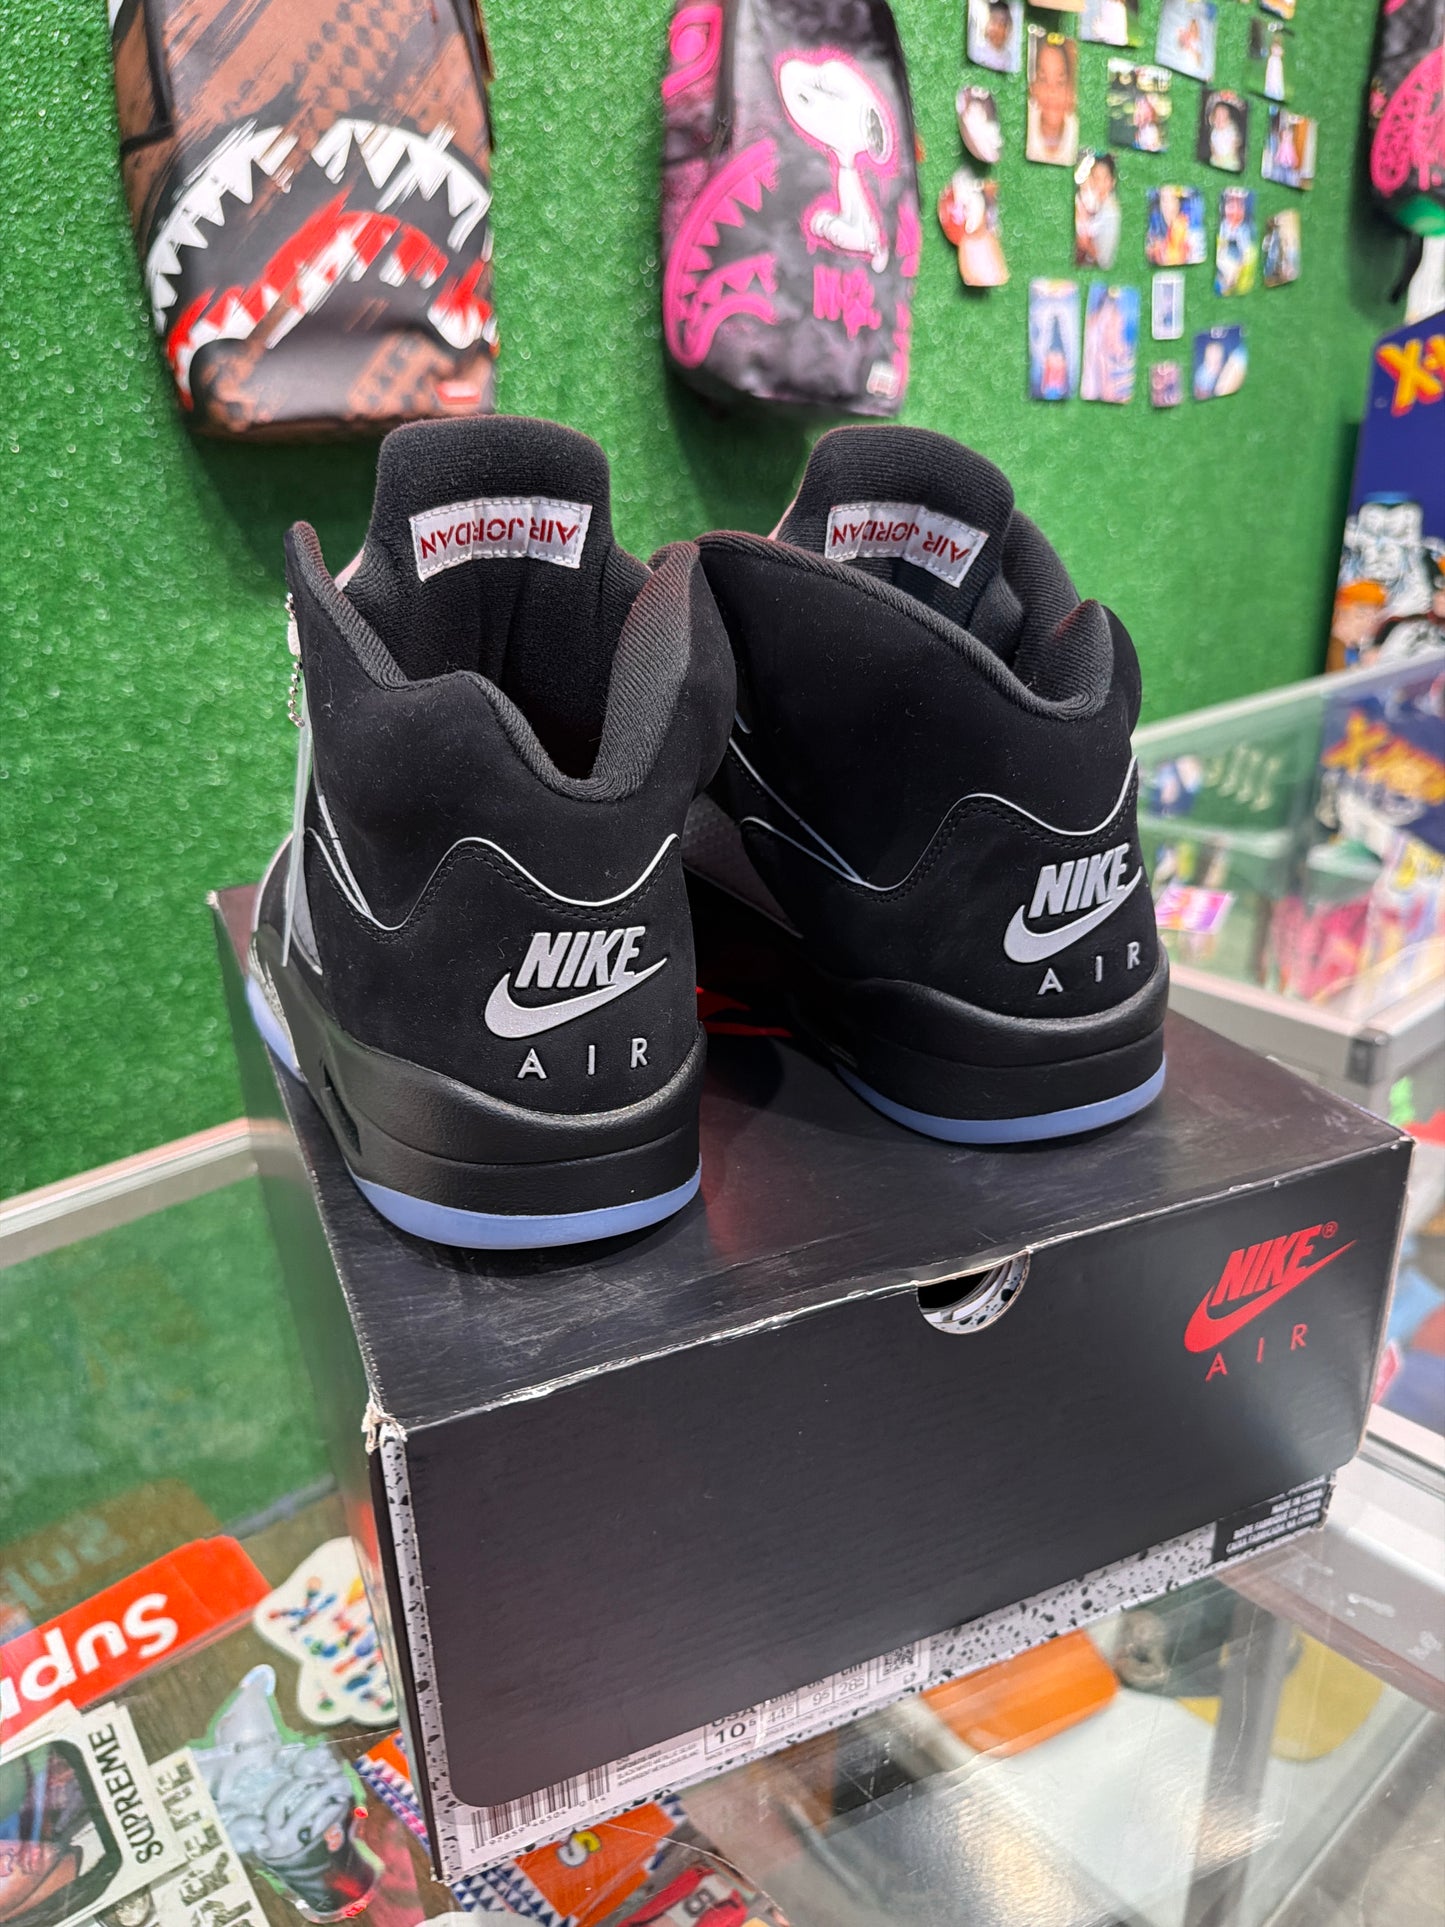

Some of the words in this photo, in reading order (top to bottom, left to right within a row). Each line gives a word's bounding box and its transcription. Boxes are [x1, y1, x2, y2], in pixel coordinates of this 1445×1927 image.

[419, 517, 525, 559] JORDAN
[529, 516, 579, 546] AIR
[831, 519, 920, 547] JORDAN
[921, 531, 971, 564] AIR
[1028, 842, 1130, 919] NIKE
[514, 925, 646, 988] NIKE
[1037, 941, 1141, 995] AIR
[517, 1037, 648, 1080] AIR
[1205, 1323, 1308, 1382] AIR
[88, 1722, 164, 1865] SUPREME
